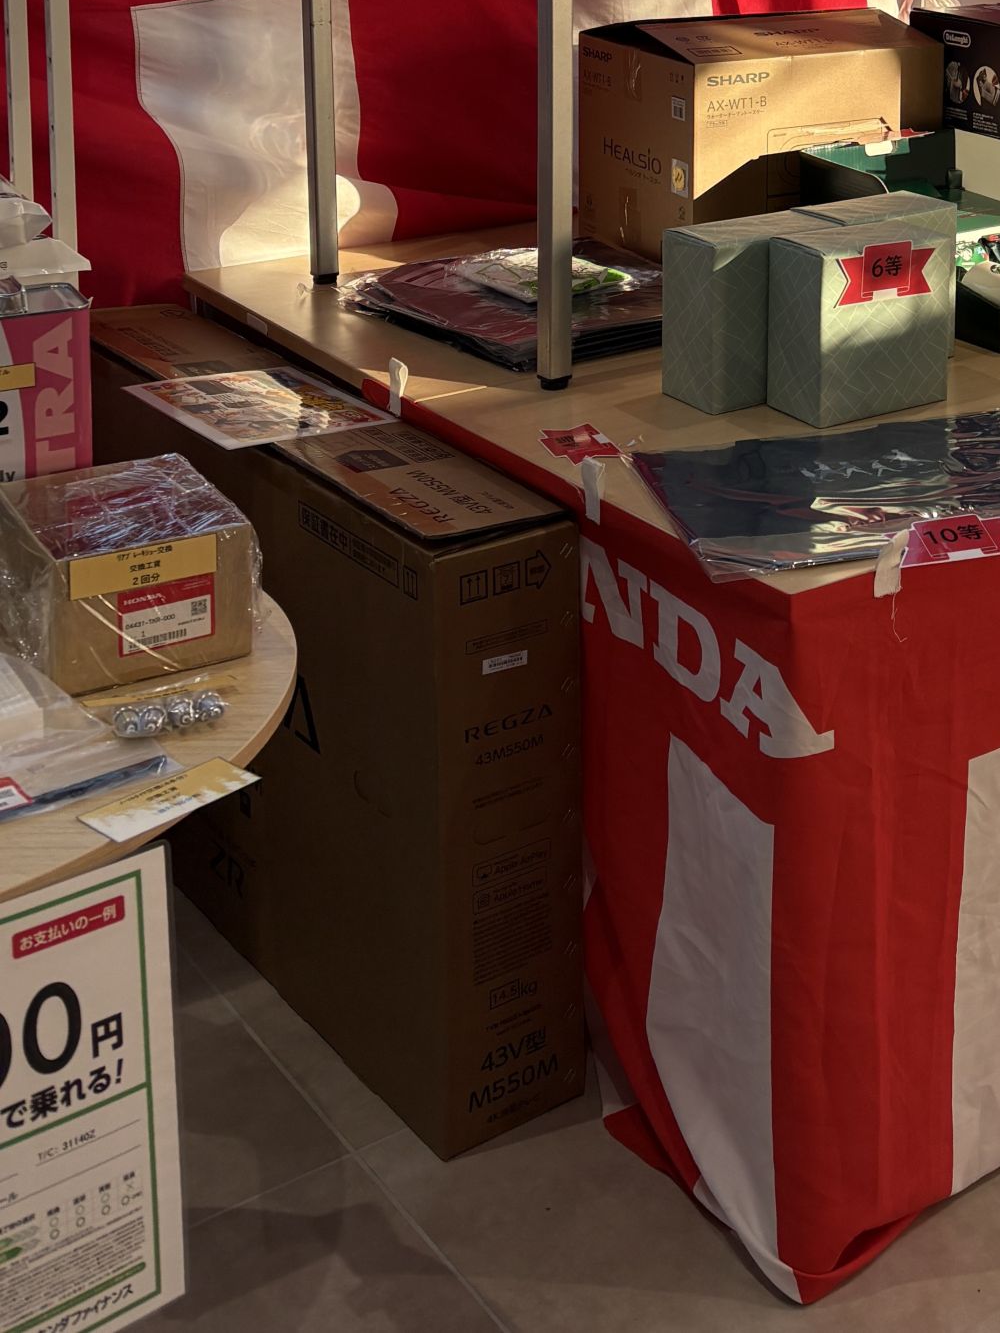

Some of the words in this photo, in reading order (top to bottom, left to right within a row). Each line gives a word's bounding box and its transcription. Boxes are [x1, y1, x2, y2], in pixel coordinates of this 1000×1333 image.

[583, 46, 612, 63] SHARP
[706, 71, 770, 87] SHARP
[706, 95, 768, 113] AX-WT1-B
[871, 255, 903, 278] 6等
[923, 523, 985, 546] 10等
[132, 573, 161, 586] 2回分
[123, 592, 163, 606] HONDA
[464, 703, 554, 744] REGZA
[474, 734, 545, 766] 43M550M
[19, 904, 117, 952] お支払いの一例
[480, 1026, 546, 1072] 43V型
[468, 1053, 559, 1113] M550M
